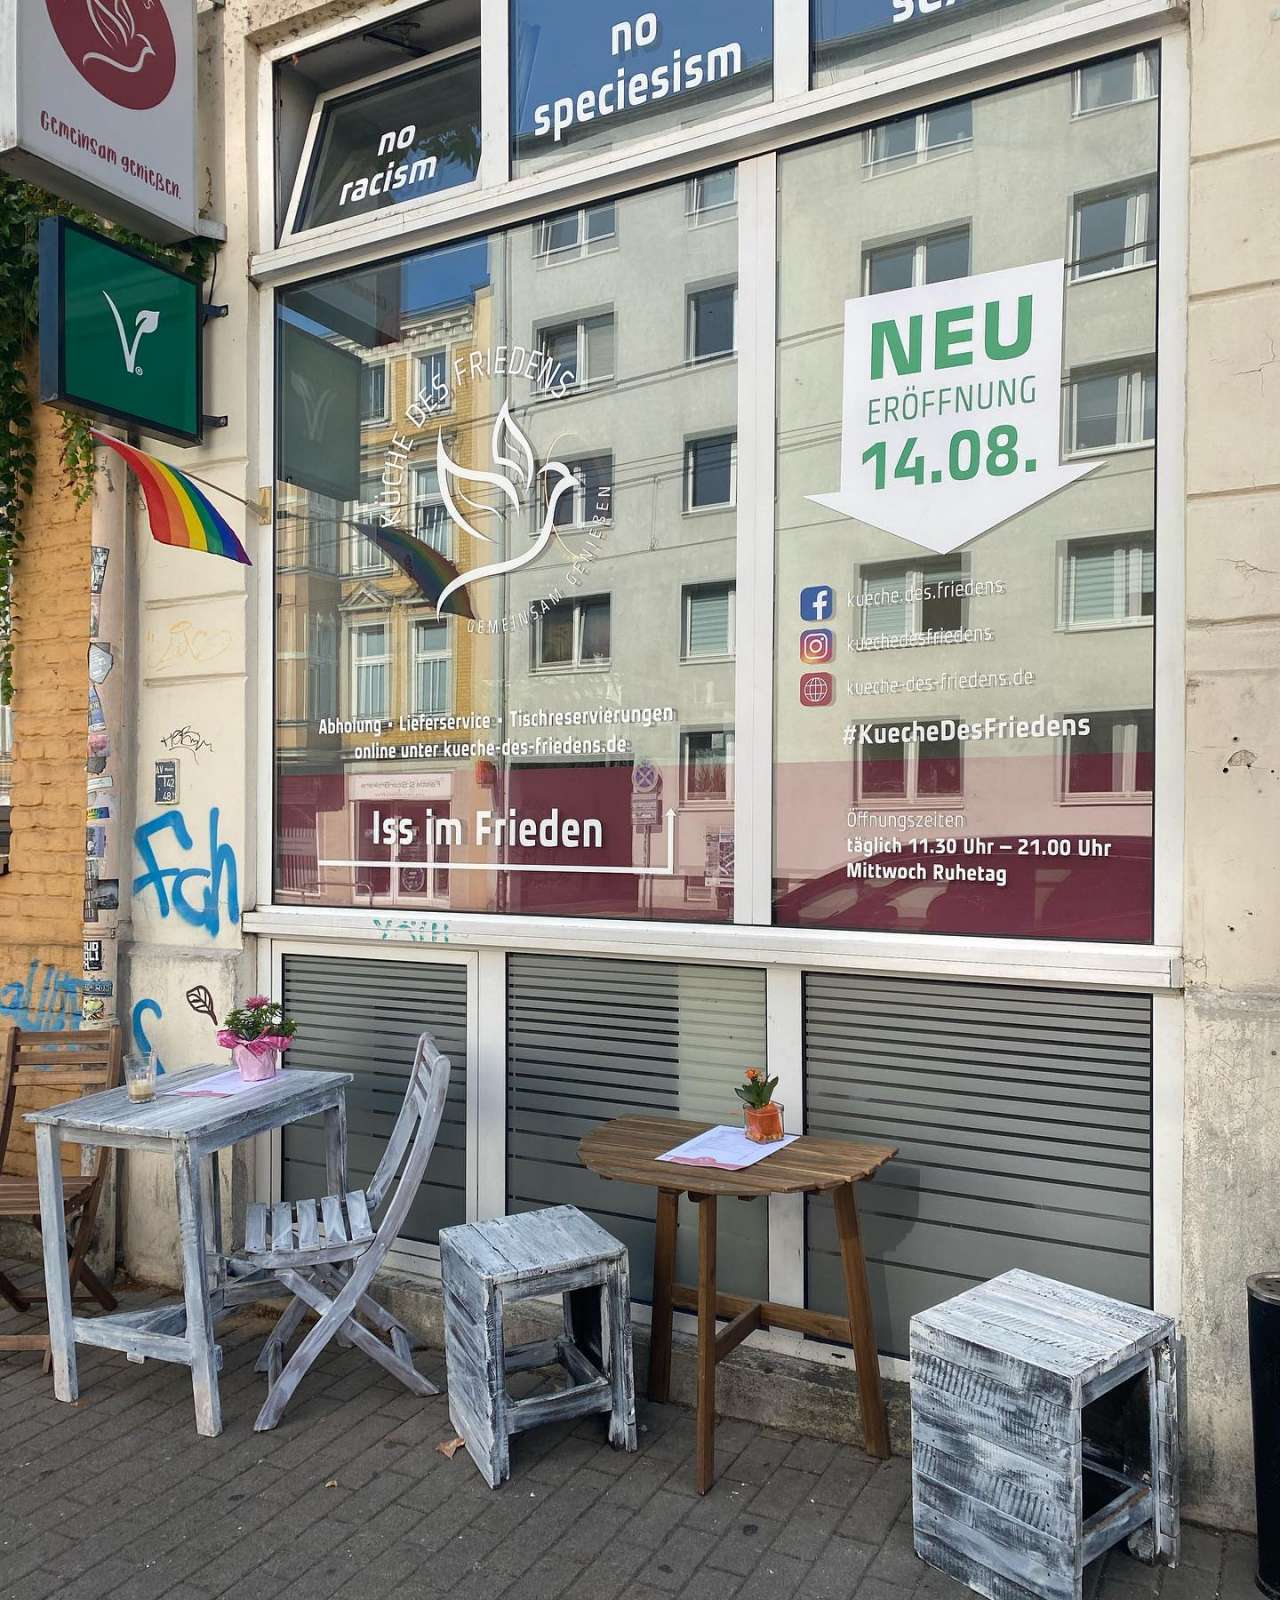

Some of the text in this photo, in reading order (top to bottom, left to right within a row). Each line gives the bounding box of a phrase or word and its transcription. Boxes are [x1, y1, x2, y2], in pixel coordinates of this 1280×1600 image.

[611, 12, 658, 56] no
[534, 41, 742, 142] speciesism
[40, 110, 117, 165] Gemeinsam
[377, 124, 417, 157] no
[339, 155, 438, 206] racism
[870, 294, 1033, 381] NEU
[405, 372, 449, 429] DES
[454, 345, 575, 399] FRIEDENS
[868, 375, 1036, 426] ERÖFFNUNG
[861, 424, 1037, 490] 14.08.
[847, 578, 1003, 608] kueche.des.friedens
[847, 625, 993, 652] kuechedesfriedens
[847, 667, 1033, 696] kueche-des-friedens.de
[318, 717, 382, 737] Abholung
[399, 712, 491, 732] Lieferservice
[509, 705, 673, 727] Tischreservierungen
[842, 714, 1091, 746] #KuecheDesFriedens
[354, 734, 627, 760] online unter kueche-des-friedens.de
[372, 809, 414, 845] Iss
[425, 808, 462, 845] im
[476, 807, 603, 848] Frieden
[847, 807, 964, 832] Öffnungszeiten
[847, 836, 902, 857] täglich
[908, 838, 957, 854] 11.30
[963, 837, 995, 855] Uhr
[1018, 838, 1071, 856] 21.00
[1078, 838, 1112, 857] Uhr
[847, 862, 1007, 887] Mittwoch Ruhetag
